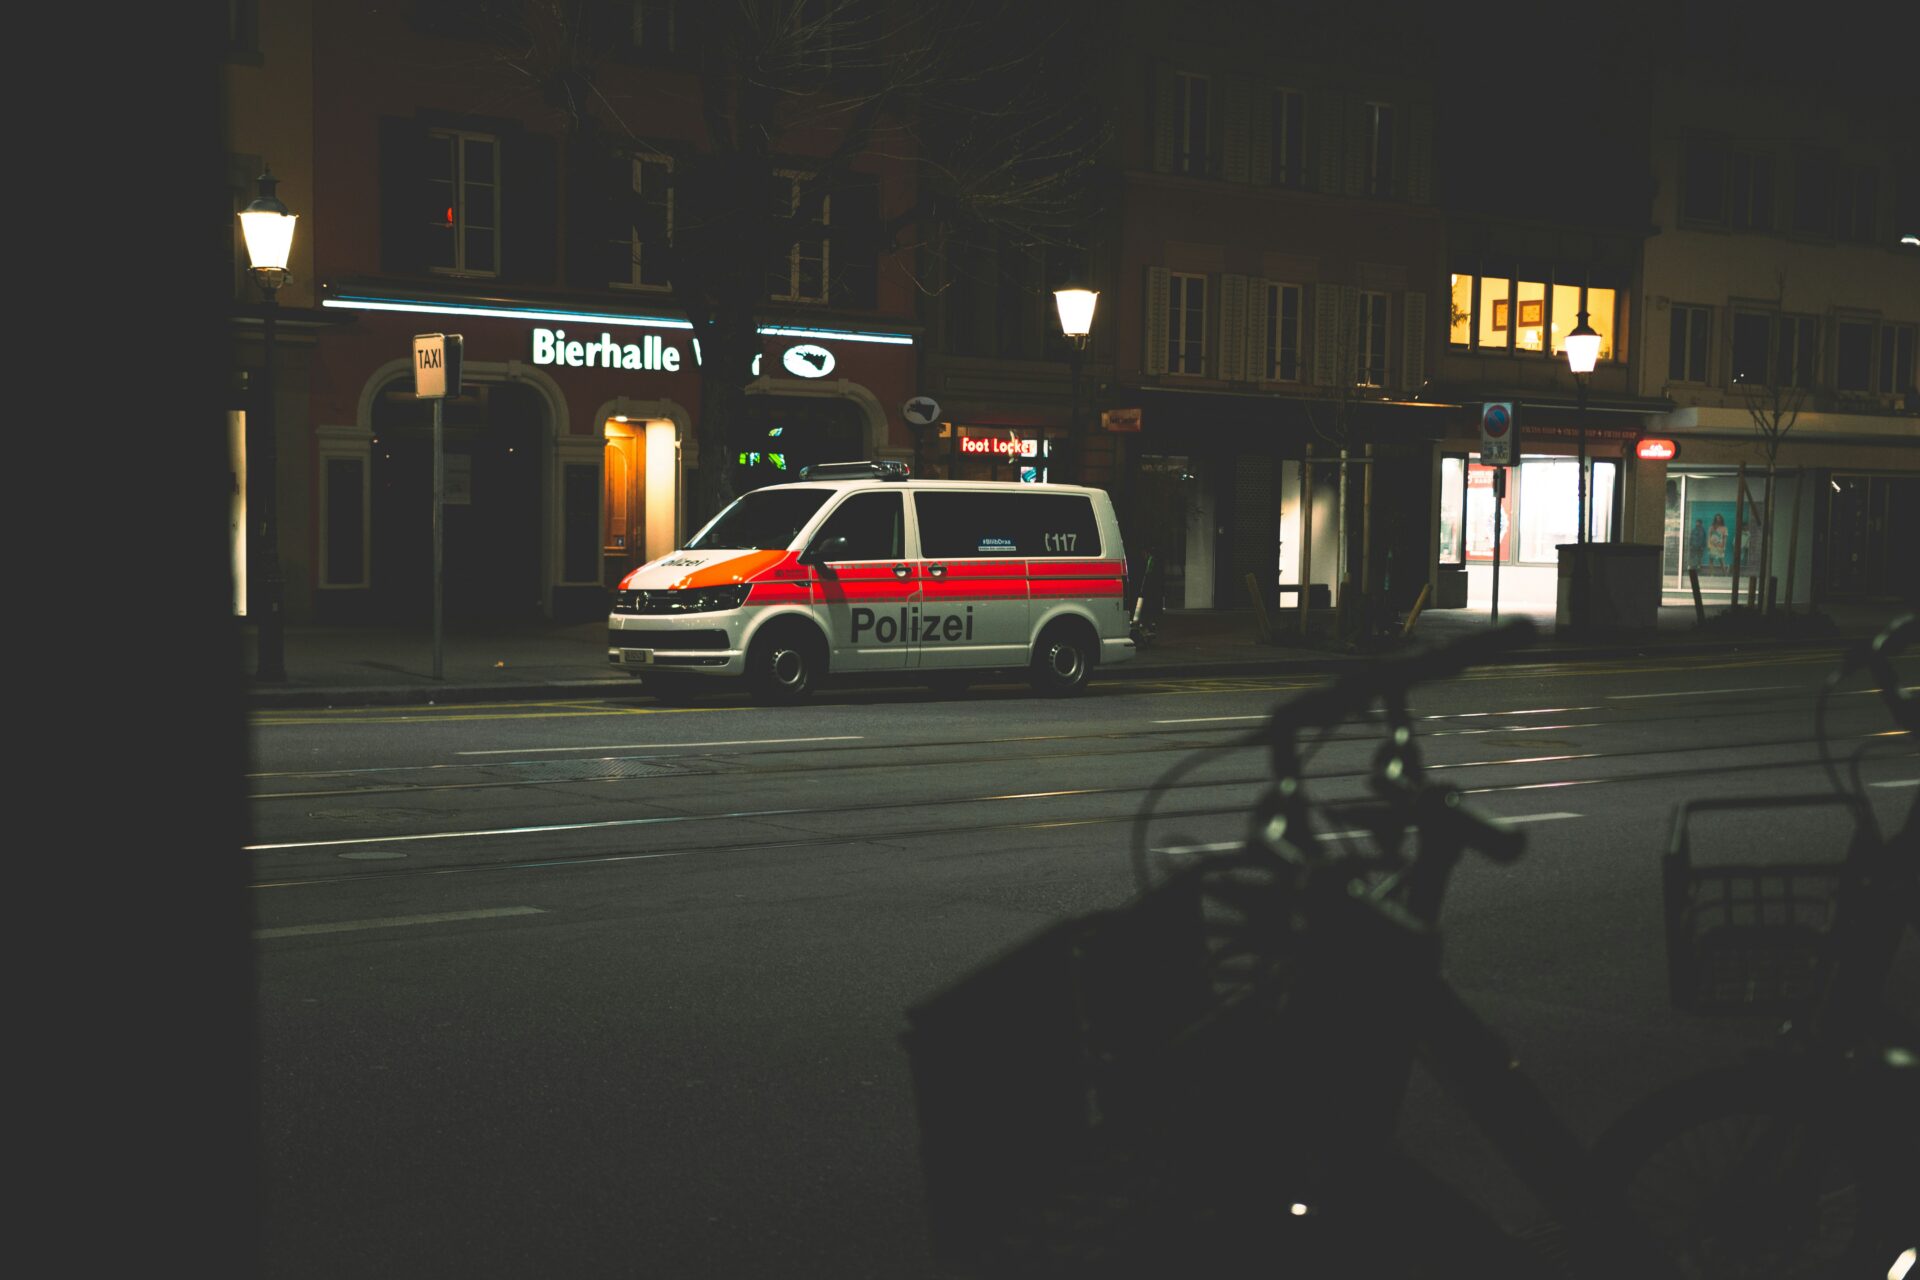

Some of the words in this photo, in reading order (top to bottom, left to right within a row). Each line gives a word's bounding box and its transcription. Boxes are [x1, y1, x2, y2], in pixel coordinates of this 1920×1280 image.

[417, 348, 442, 369] TAXI
[533, 327, 680, 372] Bierhalle
[962, 436, 990, 453] Foot
[1051, 533, 1077, 552] 117
[850, 605, 974, 644] Polizei
